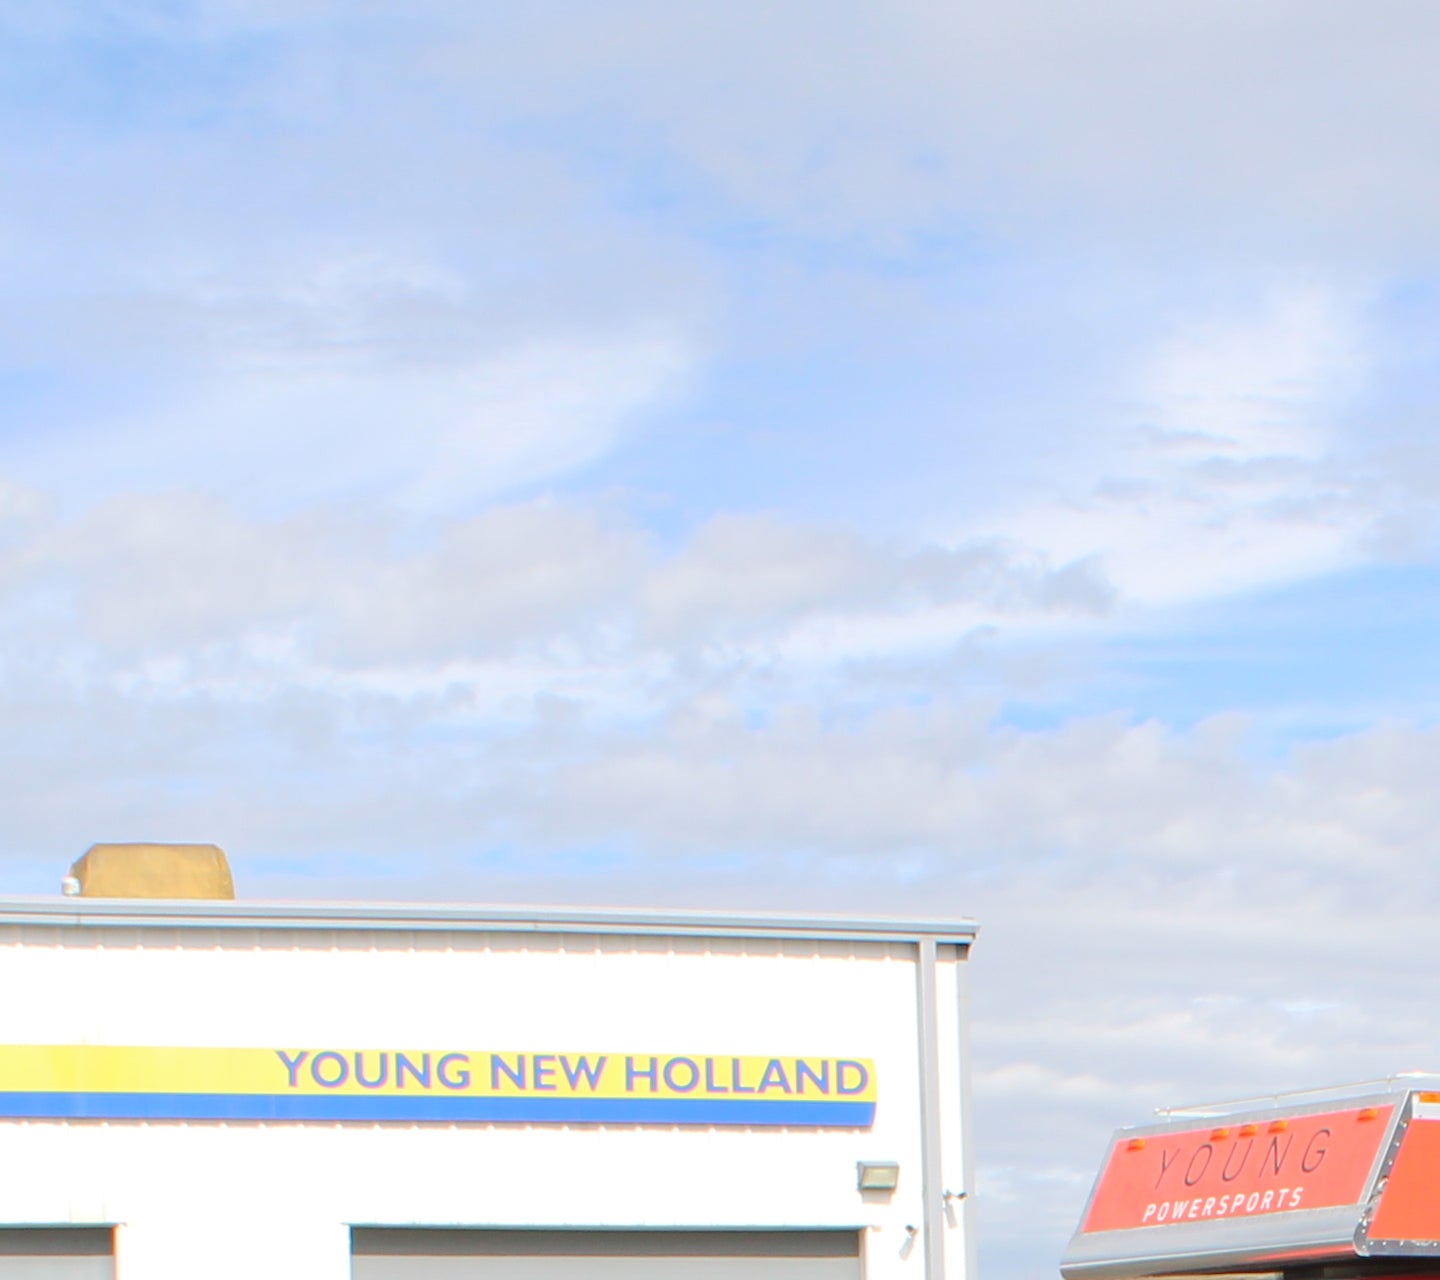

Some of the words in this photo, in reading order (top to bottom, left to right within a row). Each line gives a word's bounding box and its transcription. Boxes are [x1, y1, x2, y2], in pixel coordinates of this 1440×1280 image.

[276, 1050, 470, 1090] YOUNG
[490, 1053, 607, 1092] NEW
[626, 1056, 869, 1096] HOLLAND
[1155, 1127, 1332, 1190] YOUNG
[1142, 1187, 1306, 1224] POWERSPORTS
